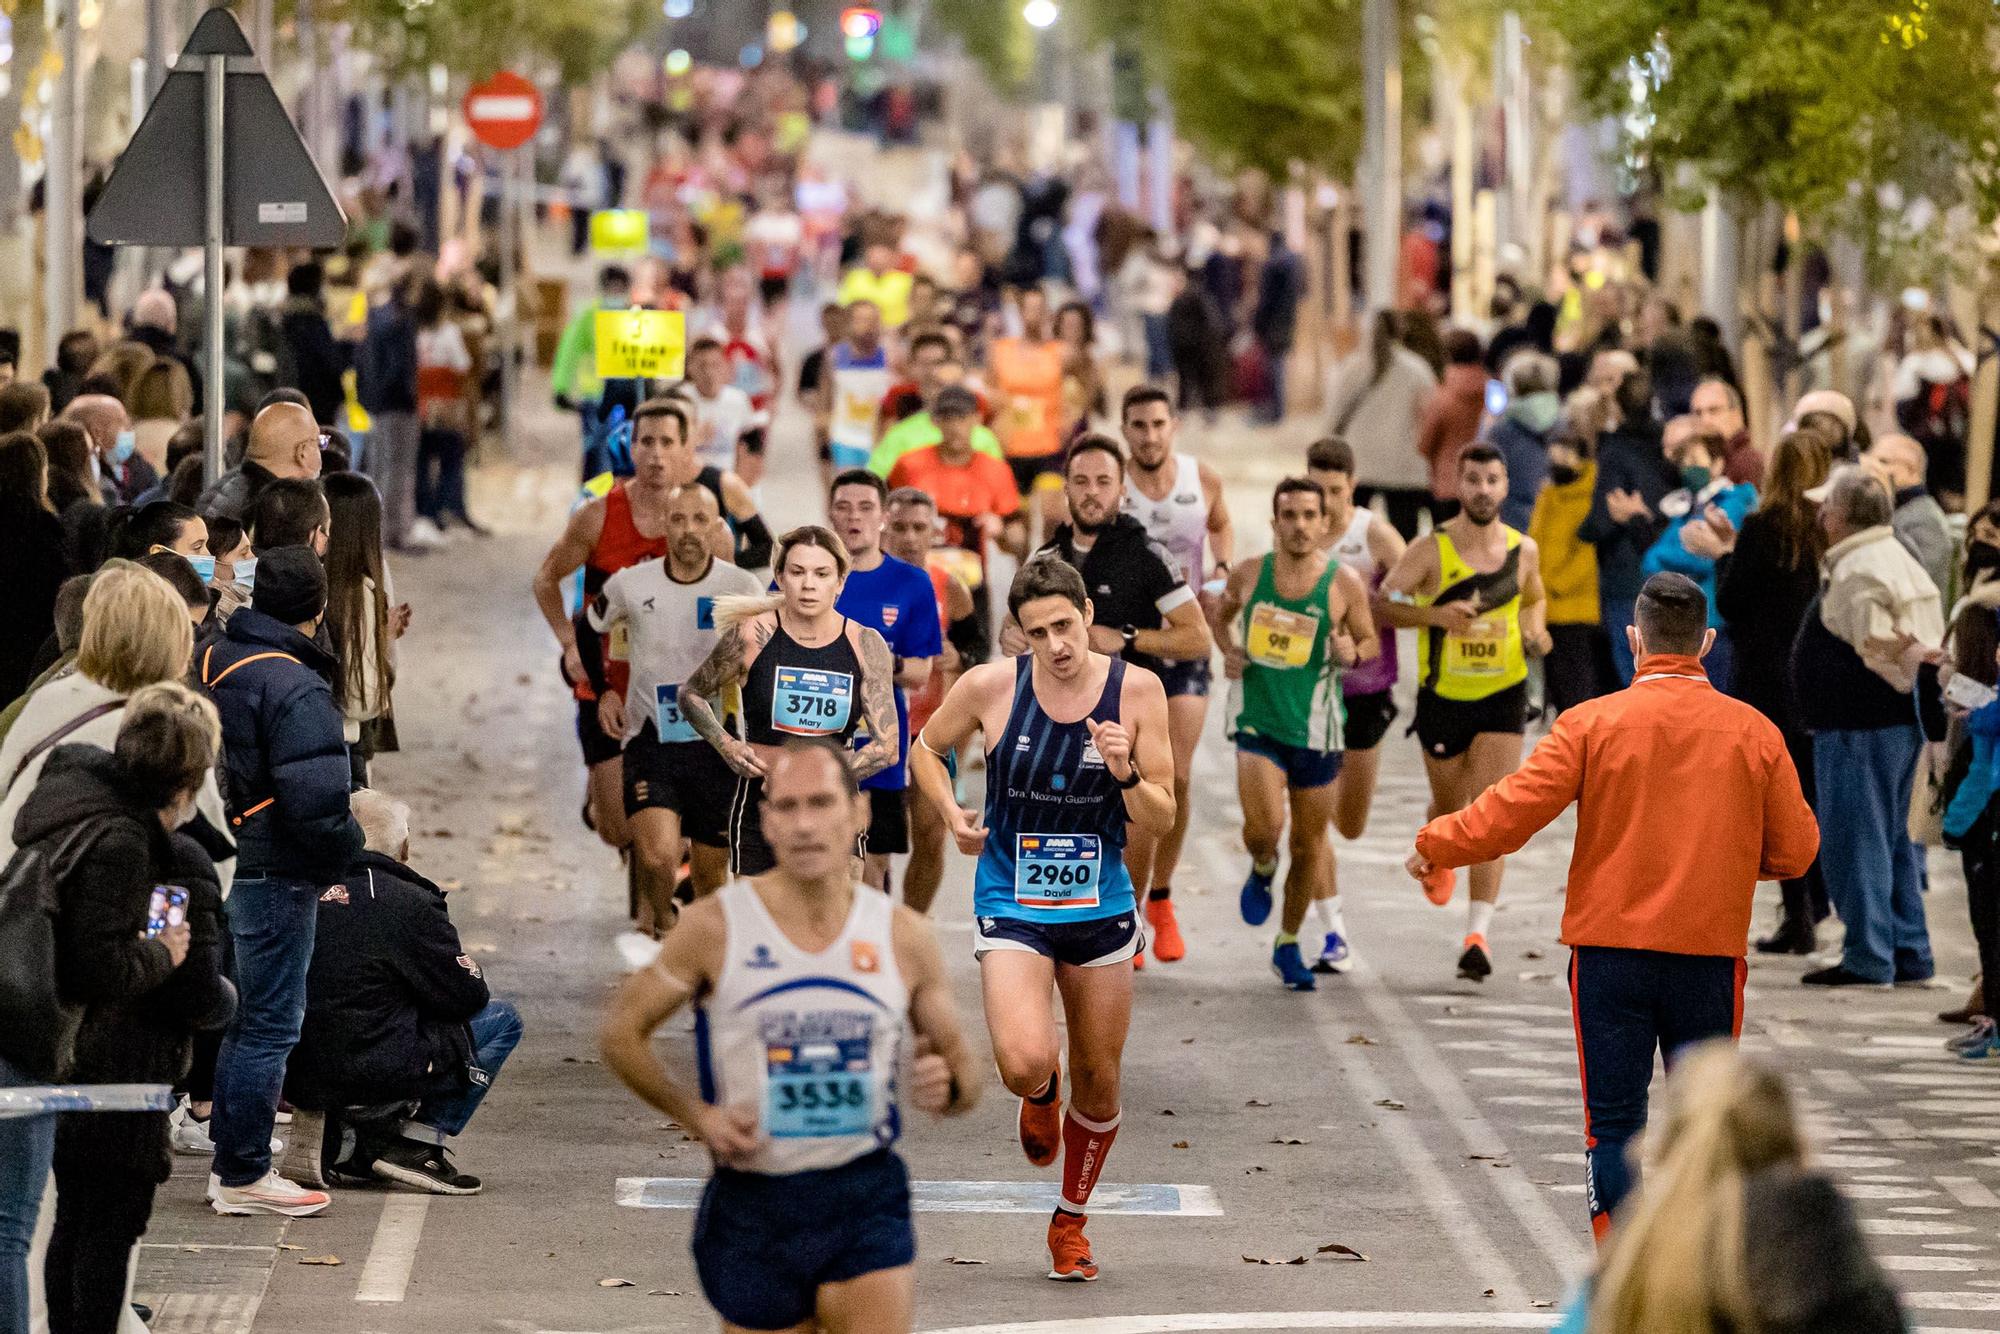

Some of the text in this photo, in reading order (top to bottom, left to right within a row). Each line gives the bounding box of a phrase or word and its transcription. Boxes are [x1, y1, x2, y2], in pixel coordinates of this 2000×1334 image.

[786, 694, 837, 717] 3718
[798, 718, 821, 728] Mary
[1008, 788, 1028, 798] Dra.
[1030, 791, 1062, 804] Nozay
[1026, 864, 1090, 885] 2960
[1044, 889, 1072, 897] David
